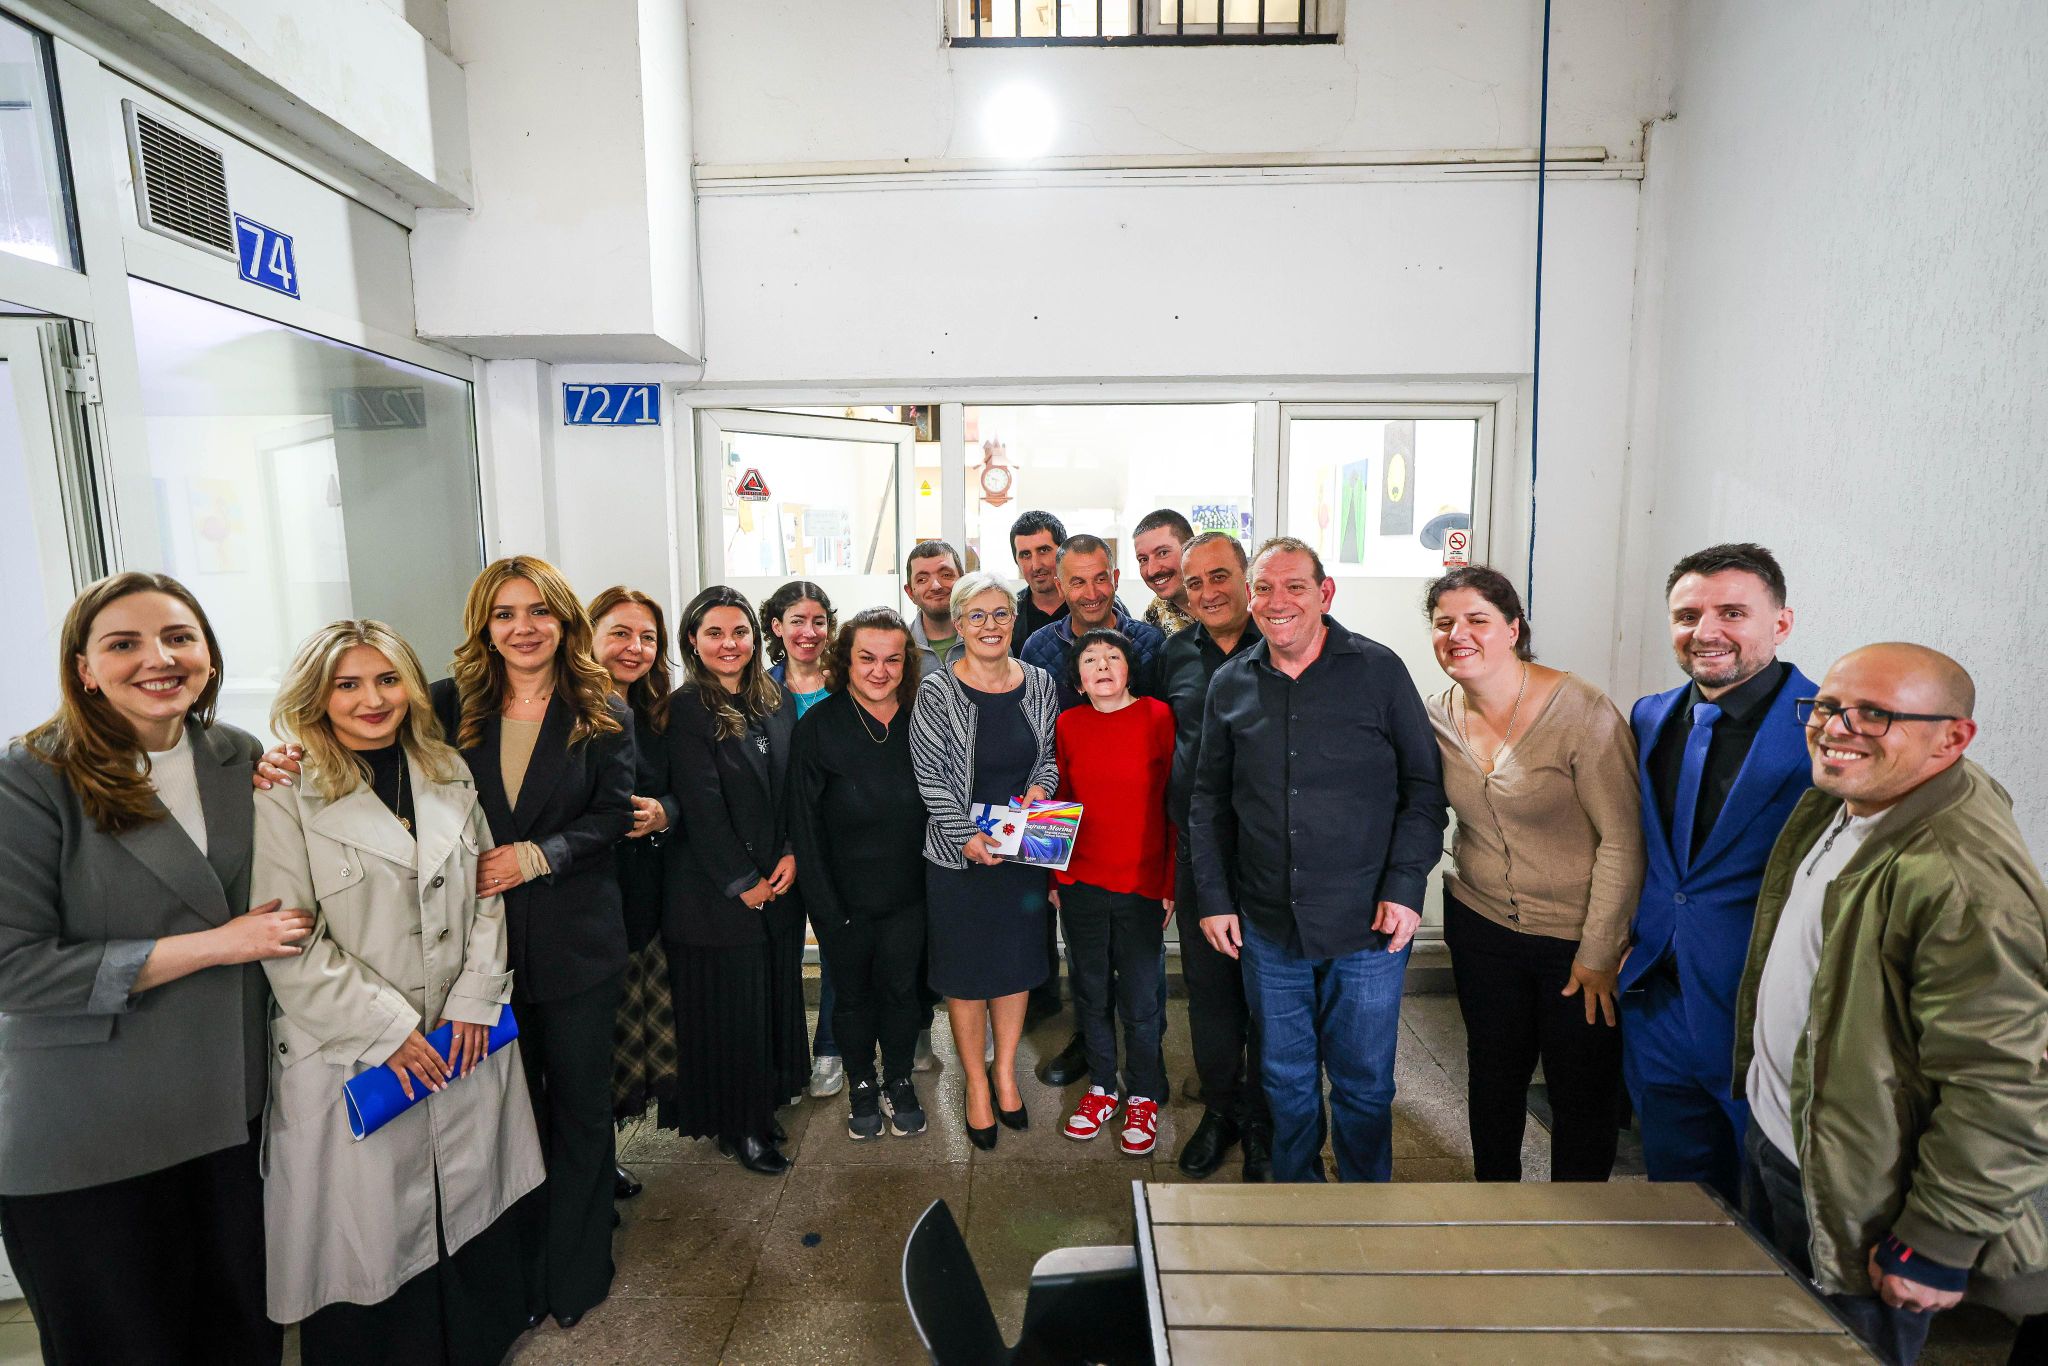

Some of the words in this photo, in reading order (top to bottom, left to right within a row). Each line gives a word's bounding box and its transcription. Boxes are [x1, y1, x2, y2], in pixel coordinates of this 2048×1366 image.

[239, 220, 292, 290] 74
[568, 386, 656, 423] 72/1
[1047, 824, 1073, 832] Morina
